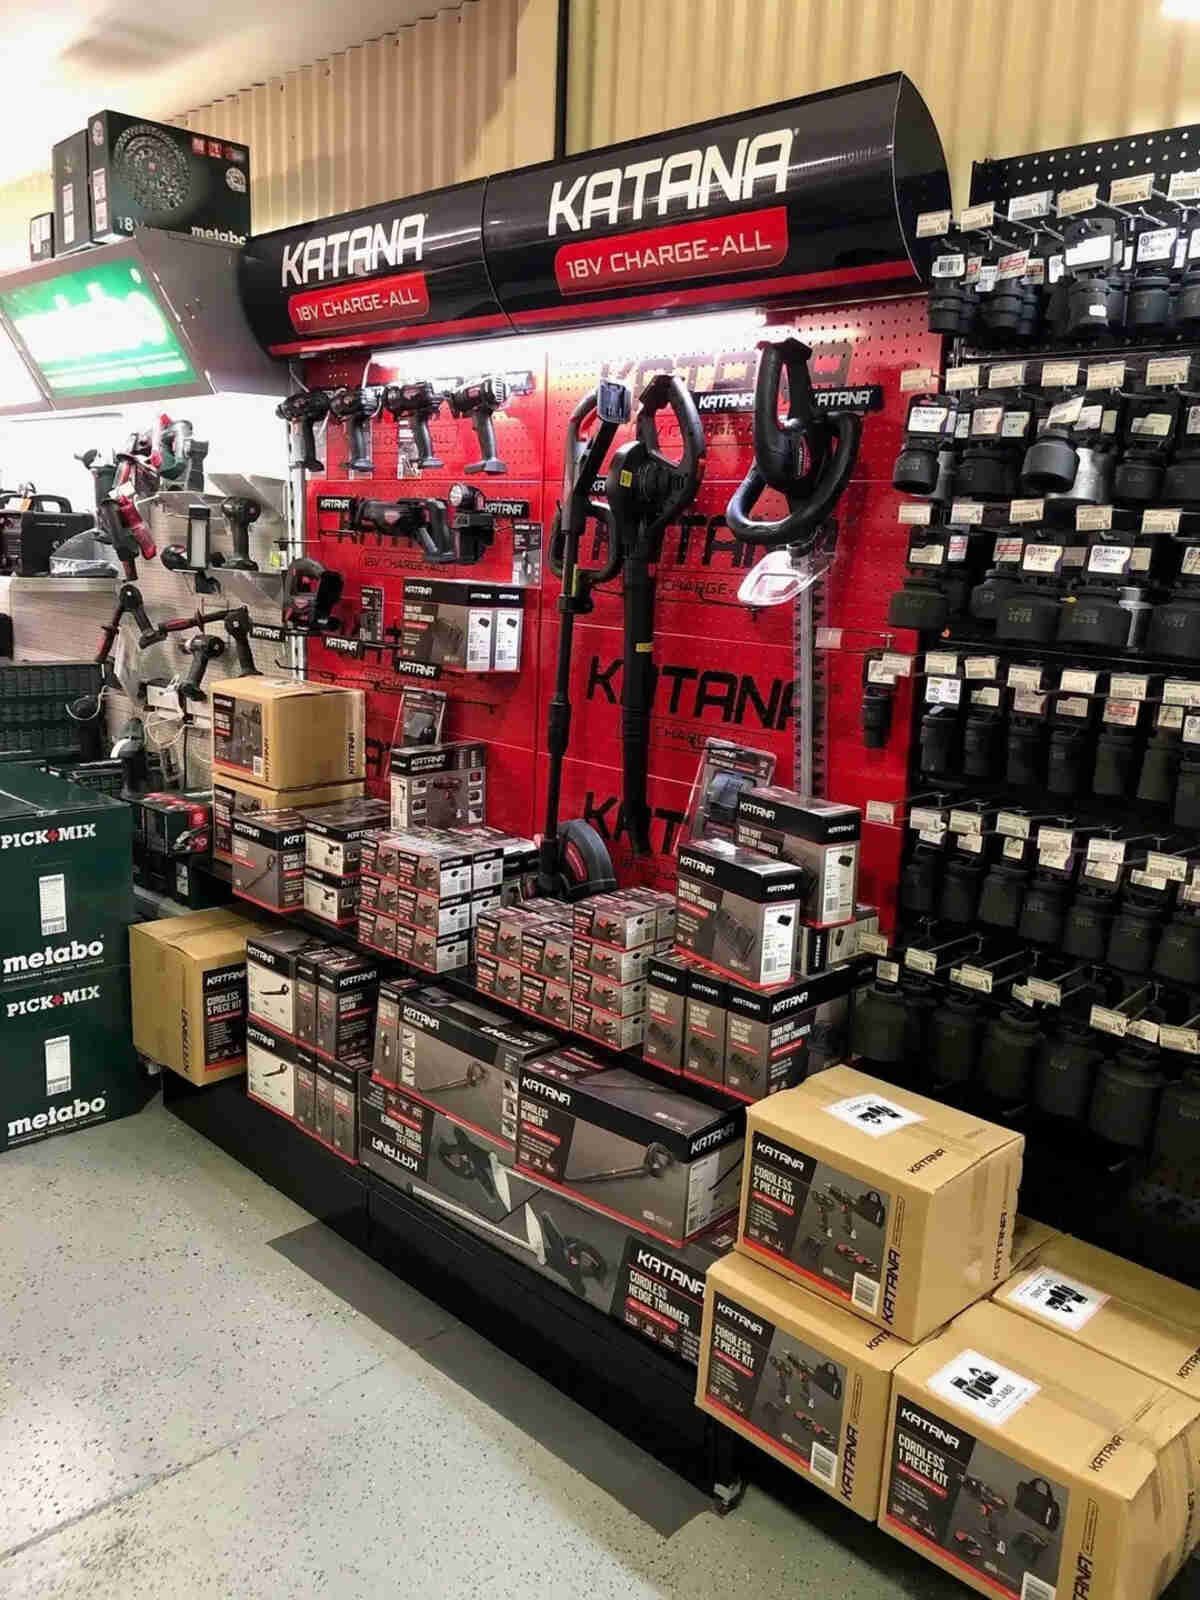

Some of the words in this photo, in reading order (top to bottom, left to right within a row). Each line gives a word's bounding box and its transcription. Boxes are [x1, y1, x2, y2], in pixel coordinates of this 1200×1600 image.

[547, 127, 794, 236] KATANA
[282, 213, 426, 287] KATANA
[566, 255, 602, 280] 18V
[609, 230, 771, 273] CHARGE-ALL
[296, 303, 320, 321] 18V
[325, 287, 420, 318] CHARGE-ALL
[815, 389, 873, 406] ATANA
[485, 502, 524, 515] KATANA
[326, 638, 358, 651] KATANA
[399, 661, 436, 677] KATANA
[739, 801, 776, 821] KATANA
[680, 855, 716, 877] KATANA
[3, 940, 104, 974] metabo
[403, 1005, 440, 1030] KATANA
[772, 992, 809, 1014] KATANA
[522, 1076, 571, 1106] KATANA
[8, 1097, 105, 1137] metabo
[372, 1137, 418, 1172] KATANA
[690, 1125, 736, 1154] KATANA
[756, 1141, 804, 1173] KATANA
[909, 1147, 947, 1175] KATANA
[752, 1177, 760, 1189] 2
[760, 1180, 781, 1201] PIECE
[782, 1191, 795, 1207] KIT
[754, 1164, 793, 1193] CORDLESS
[629, 1270, 668, 1301] CORDLESS
[882, 1247, 901, 1326] KATANA
[628, 1283, 653, 1307] HEDGE
[654, 1298, 690, 1328] TRIMMER
[717, 1301, 763, 1336] KATANA
[713, 1335, 720, 1347] 2
[720, 1339, 741, 1361] PIECE
[742, 1351, 756, 1369] KIT
[715, 1323, 752, 1355] CORDLESS
[901, 1407, 960, 1449] KATANA
[841, 1422, 859, 1501] KATANA
[898, 1433, 946, 1472] CORDLESS
[1089, 1434, 1125, 1472] KATANA
[905, 1451, 931, 1478] PIECE
[932, 1468, 949, 1488] KIT
